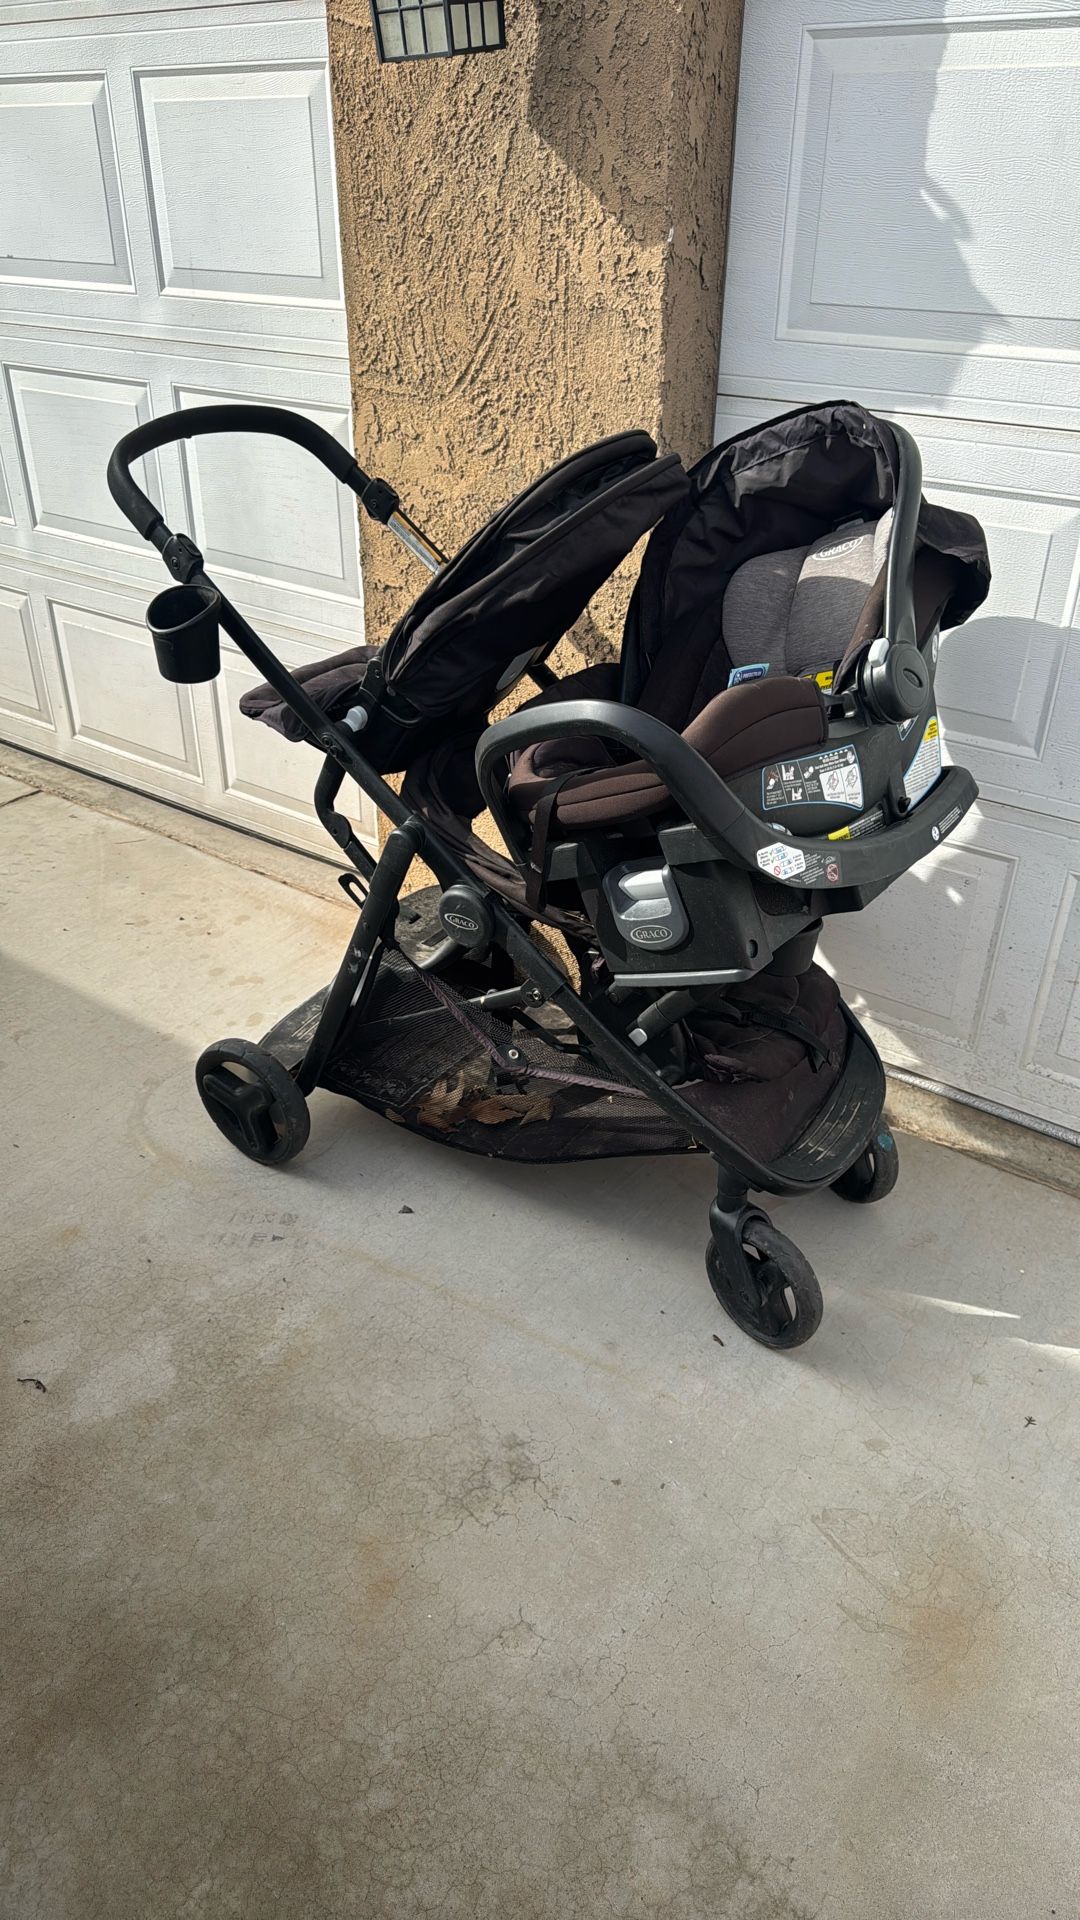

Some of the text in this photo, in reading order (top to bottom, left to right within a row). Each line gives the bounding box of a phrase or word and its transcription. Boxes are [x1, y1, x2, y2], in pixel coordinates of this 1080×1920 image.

[820, 540, 857, 558] GRACO
[449, 915, 475, 928] GRACO
[635, 929, 668, 940] GRACO
